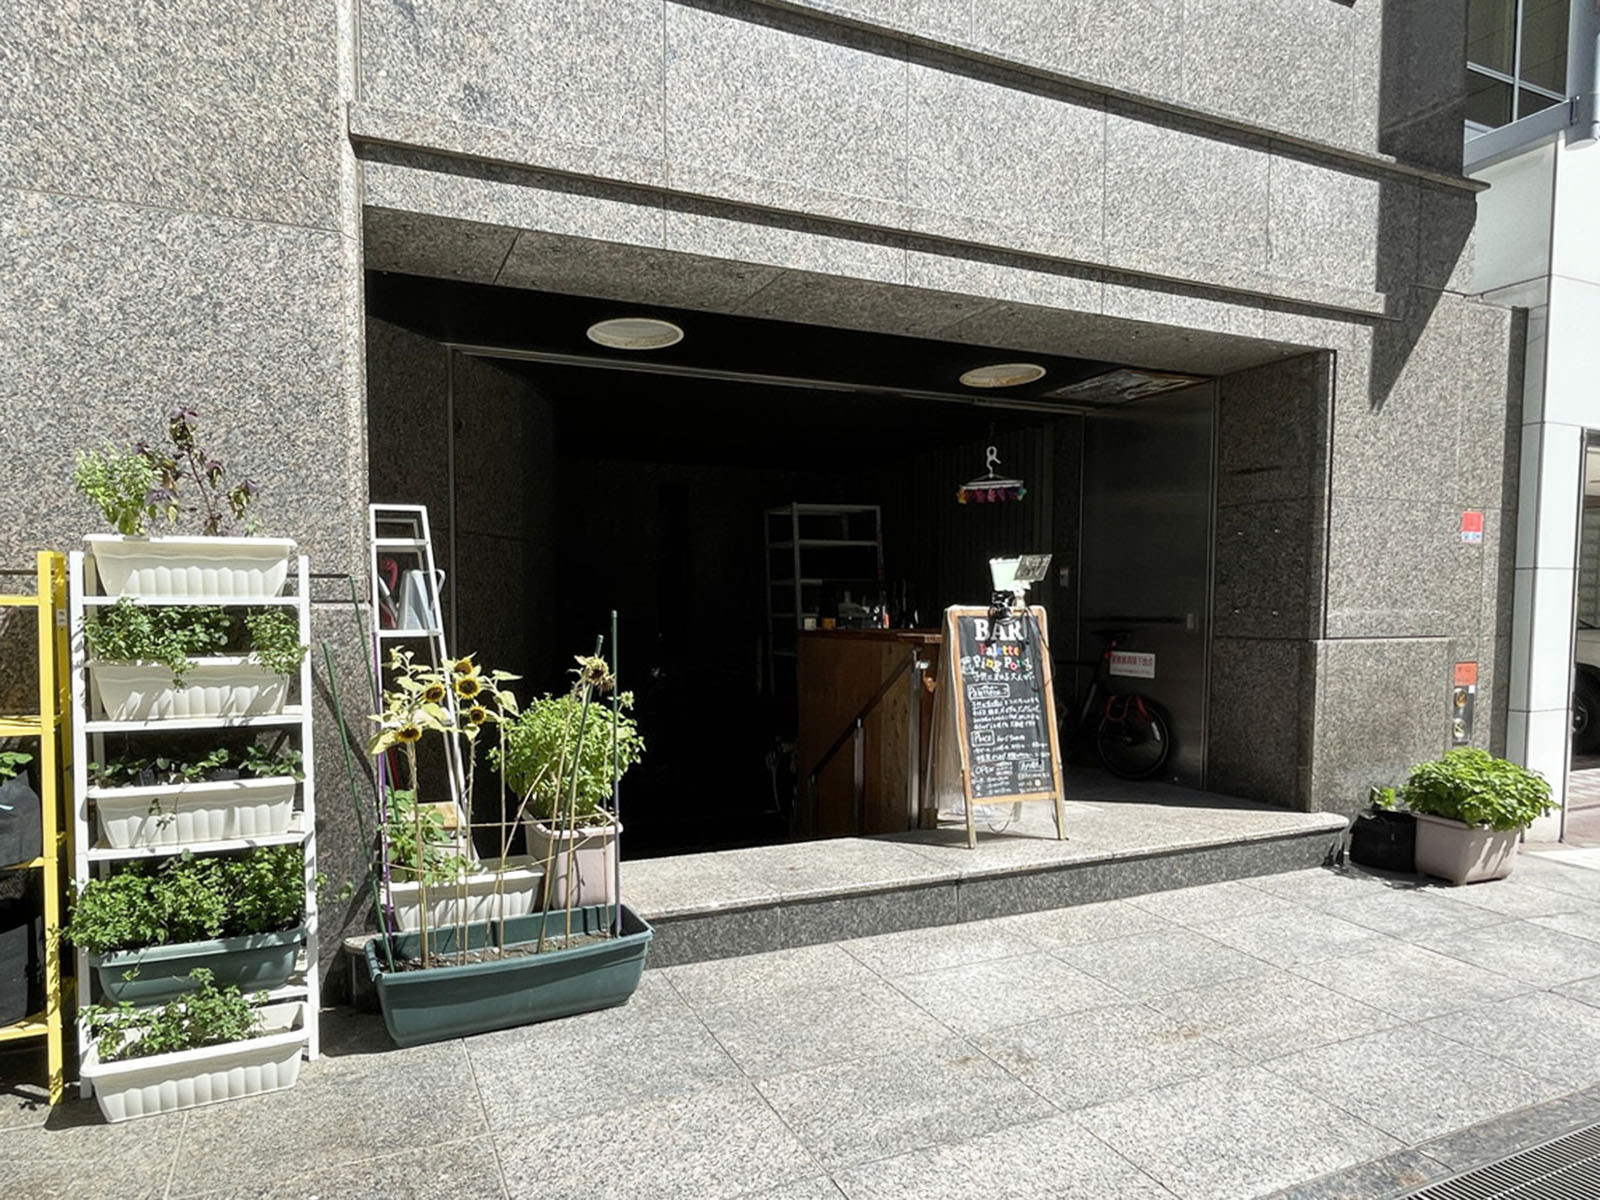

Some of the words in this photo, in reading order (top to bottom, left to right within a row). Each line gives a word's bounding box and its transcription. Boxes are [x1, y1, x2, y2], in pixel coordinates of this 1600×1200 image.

[974, 618, 1024, 641] BAR
[979, 643, 1020, 656] Palette
[973, 655, 1002, 673] Ping
[1004, 656, 1032, 671] Pong
